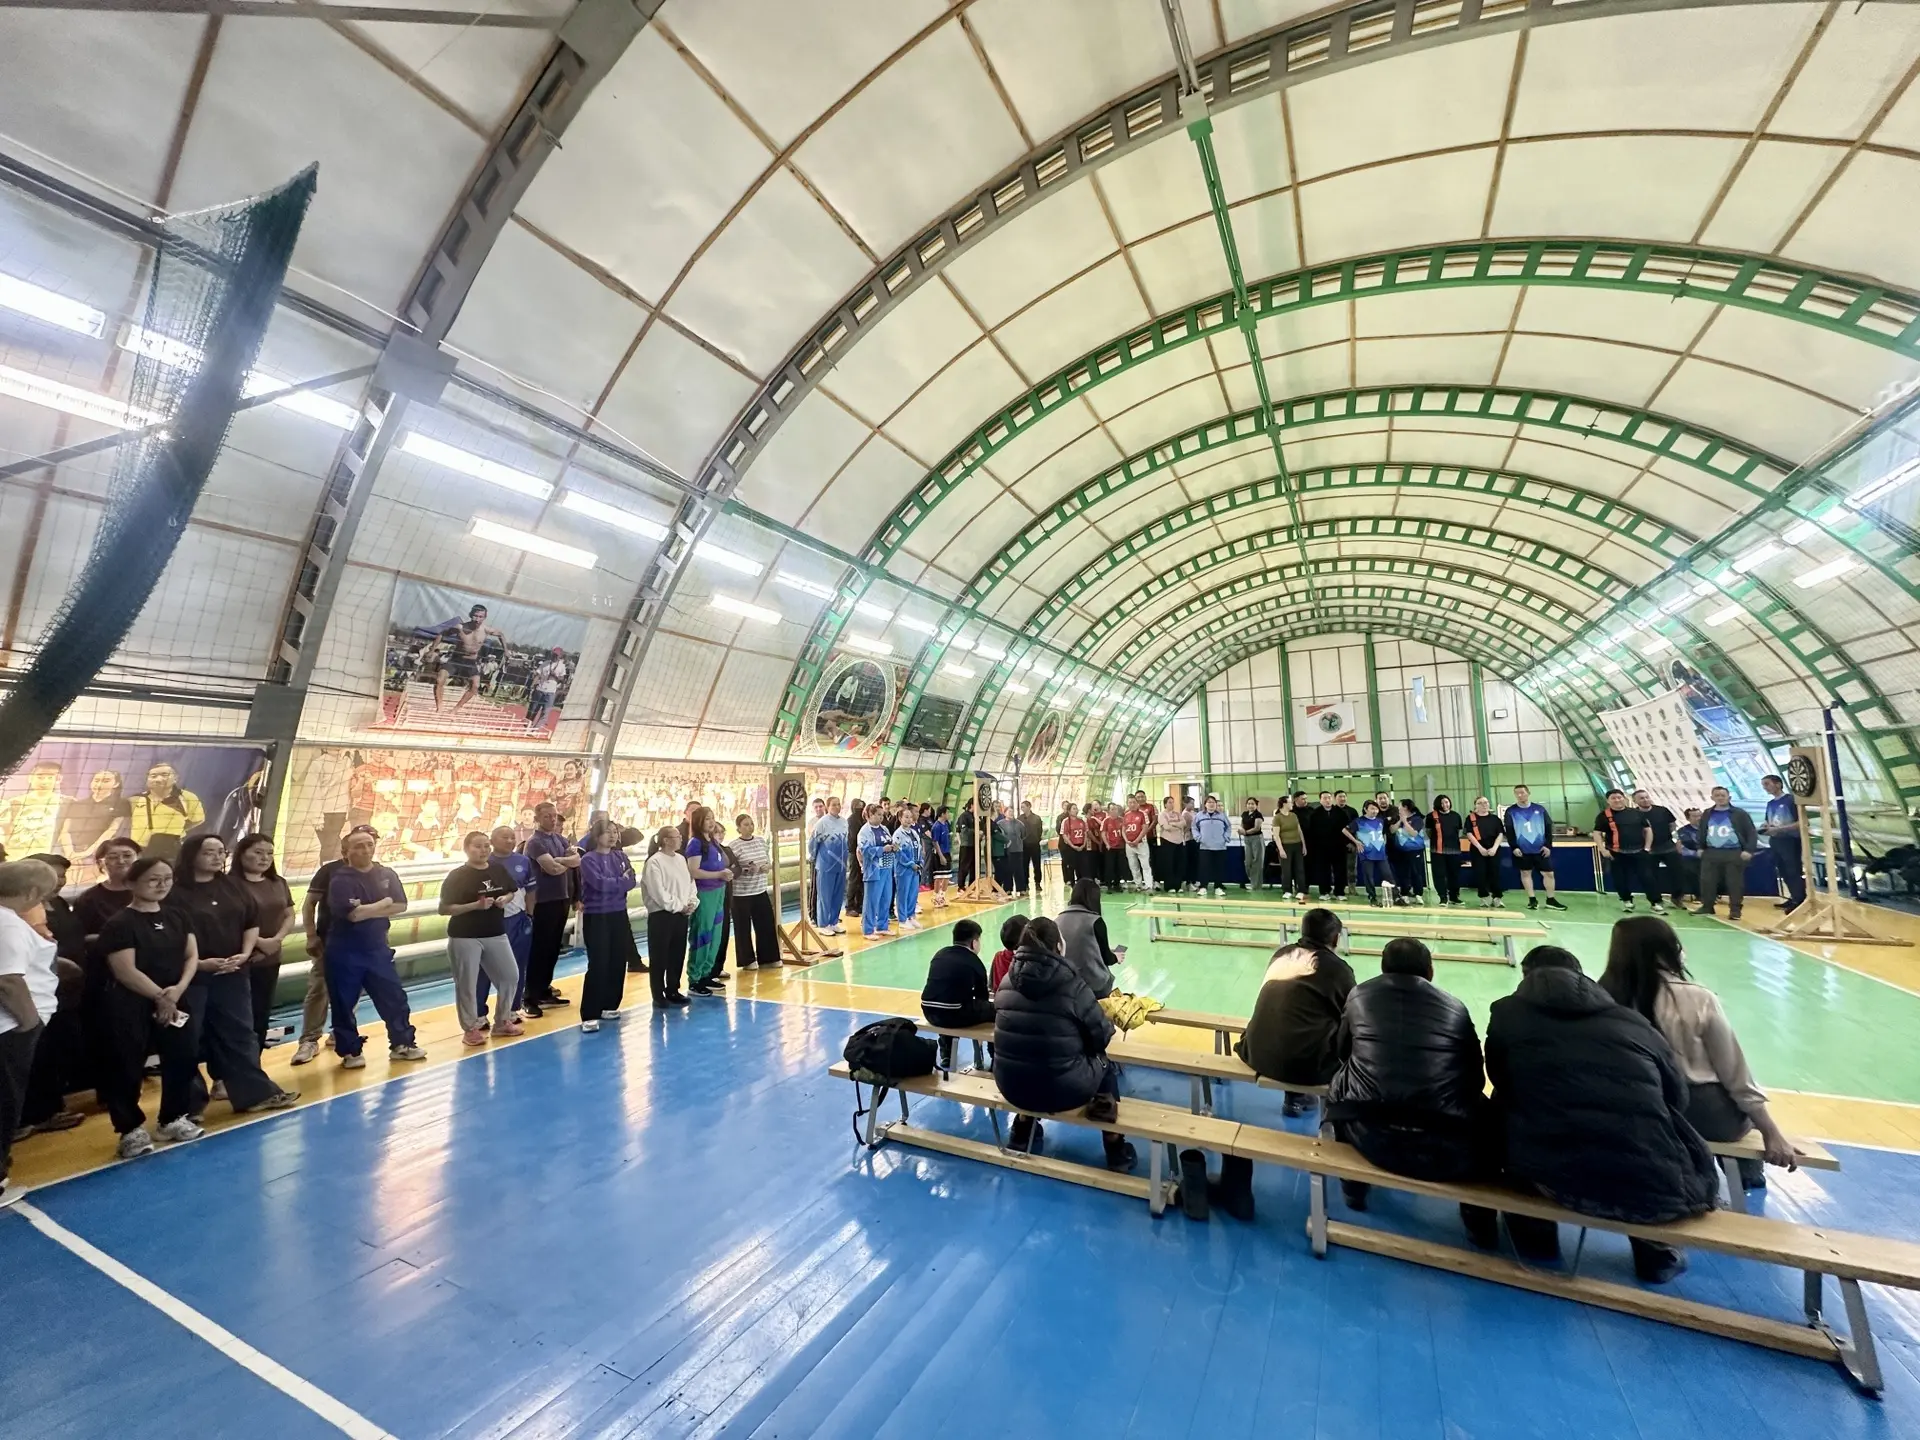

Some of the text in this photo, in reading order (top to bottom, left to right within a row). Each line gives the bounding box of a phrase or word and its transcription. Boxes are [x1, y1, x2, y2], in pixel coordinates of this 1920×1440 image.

[1126, 823, 1136, 832] 20
[1524, 821, 1532, 833] 1
[1074, 829, 1083, 838] 22
[1113, 829, 1121, 838] 11
